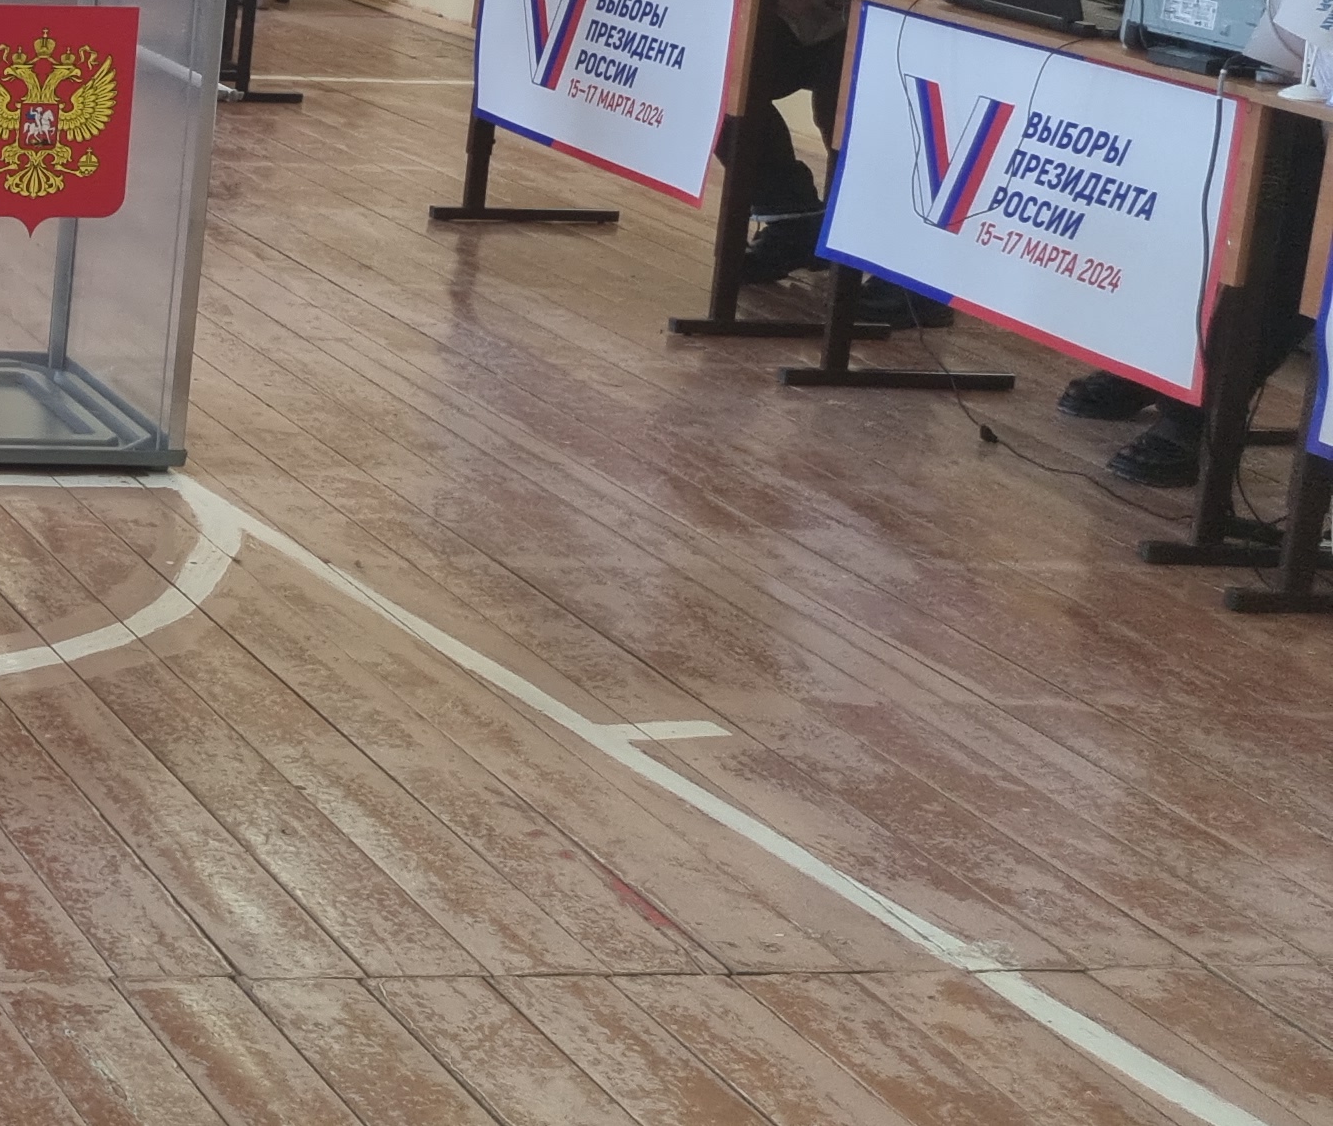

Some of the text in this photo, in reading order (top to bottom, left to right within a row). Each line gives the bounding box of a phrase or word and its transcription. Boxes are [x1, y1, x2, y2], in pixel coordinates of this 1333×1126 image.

[574, 49, 639, 89] РОССИИ
[584, 19, 686, 70] ПРЕЗИДЕНТА
[596, 88, 635, 119] МАРТА
[634, 102, 665, 128] 2024
[1022, 111, 1132, 167] ВЫБОРЫ
[988, 185, 1086, 240] РОССИИ
[1003, 149, 1158, 221] ПРЕЗИДЕНТА
[1019, 237, 1079, 278] МАРТА
[1076, 258, 1123, 294] 2024
